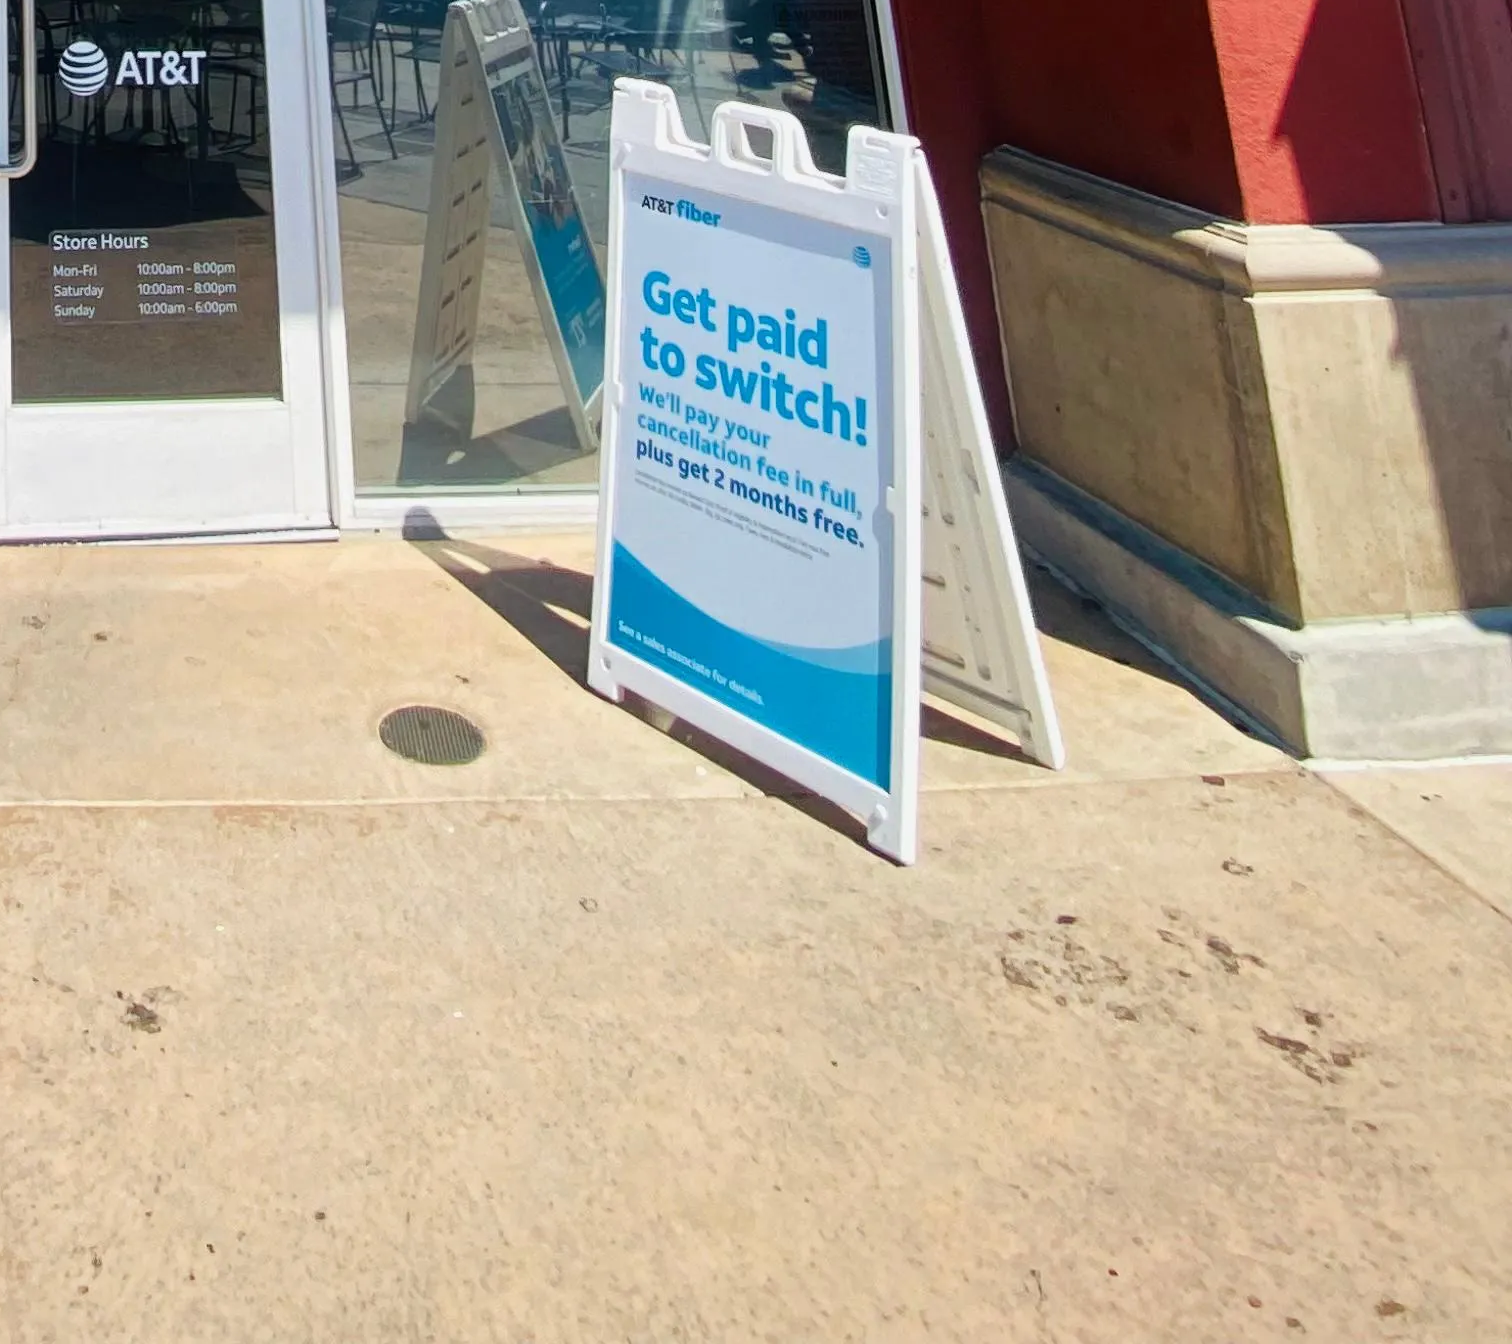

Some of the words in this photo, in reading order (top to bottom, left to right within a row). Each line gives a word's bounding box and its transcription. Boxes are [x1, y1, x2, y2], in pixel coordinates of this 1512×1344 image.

[115, 51, 207, 86] AT&T
[641, 195, 675, 215] AT&T
[676, 199, 721, 227] fiber
[53, 234, 98, 251] Store
[101, 233, 149, 250] Hours
[53, 263, 98, 277] Mon-Fri
[137, 262, 184, 275] 10:00am
[193, 261, 236, 276] 8:00pm
[53, 284, 105, 299] Saturday
[137, 283, 185, 295] 10:00am
[194, 281, 237, 296] 8:00pm
[54, 303, 96, 319] Sunday
[138, 302, 186, 315] 10:00am
[642, 270, 717, 332] Get
[727, 304, 828, 369] paid
[640, 325, 685, 378] to
[695, 354, 867, 447] switch!
[638, 382, 681, 415] We'll
[685, 403, 720, 433] pay
[724, 418, 771, 450] your
[637, 413, 752, 472] cancellation
[756, 455, 790, 487] fee
[794, 469, 815, 497] in
[819, 480, 863, 520] full,
[636, 438, 675, 469] plus
[678, 458, 710, 484] get
[713, 468, 725, 490] 2
[729, 478, 809, 525] months
[813, 508, 865, 548] free.
[712, 668, 727, 687] for
